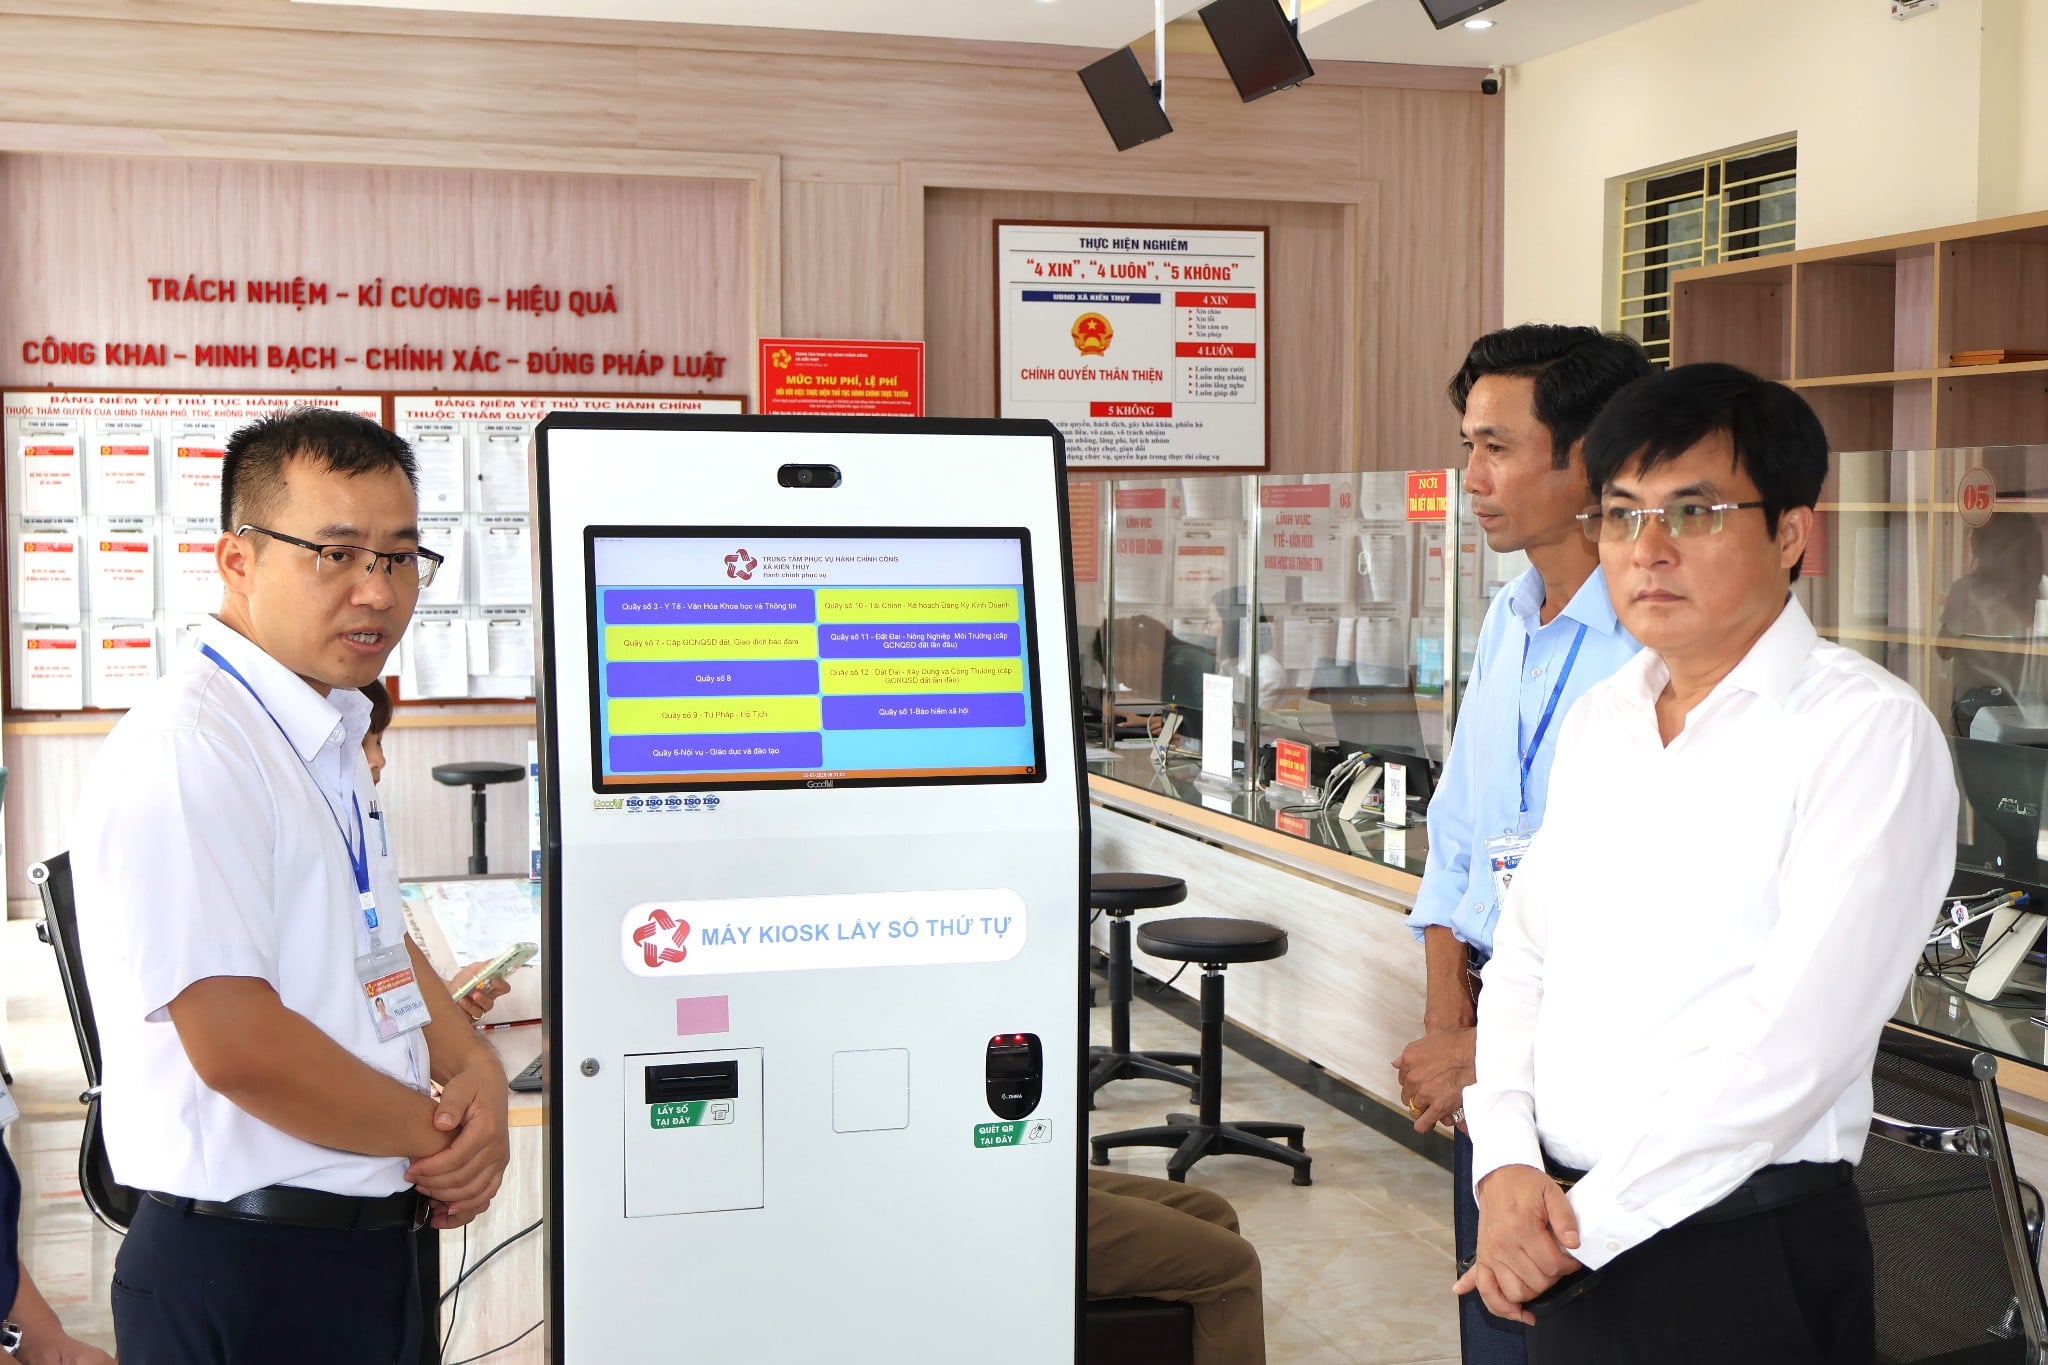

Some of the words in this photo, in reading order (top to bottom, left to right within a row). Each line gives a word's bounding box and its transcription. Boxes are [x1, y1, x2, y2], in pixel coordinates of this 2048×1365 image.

[1080, 238, 1109, 251] THỰC
[1113, 238, 1140, 252] HIỆN
[1144, 238, 1188, 251] NGHIÊM
[148, 274, 235, 302] TRÁCH
[248, 276, 327, 311] NHIỆM
[358, 277, 382, 307] KỈ
[391, 283, 481, 310] CƯƠNG
[506, 284, 560, 317] HIỆU
[568, 284, 618, 317] QUẢ
[1053, 293, 1075, 301] UBND
[1077, 293, 1088, 301] XÃ
[1090, 292, 1109, 302] KIẾN
[1111, 294, 1130, 303] THỤY
[1203, 295, 1208, 305] 4
[1210, 295, 1229, 305] XIN
[1197, 346, 1203, 356] 4
[1205, 344, 1234, 356] LUÔN
[22, 336, 95, 364] CÔNG
[105, 343, 166, 366] KHAI
[195, 344, 257, 367] MINH
[267, 345, 336, 374] BẠCH
[366, 344, 442, 371] CHÍNH
[452, 345, 500, 372] XÁC
[527, 347, 594, 374] ĐÚNG
[603, 350, 664, 377] PHÁP
[673, 351, 727, 382] LUẬT
[1021, 366, 1055, 380] CHÍNH
[1058, 364, 1096, 381] QUYỀN
[1099, 367, 1129, 381] THÂN
[1131, 367, 1163, 384] THIỆN
[786, 374, 812, 385] MỨC
[816, 376, 837, 385] THU
[840, 375, 861, 386] PHÍ,
[865, 375, 875, 387] LỆ
[879, 376, 897, 386] PHÍ
[50, 394, 94, 404] BẢNG
[99, 395, 138, 405] NIÊM
[143, 394, 170, 405] YẾT
[176, 394, 205, 406] THỦ
[213, 398, 240, 407] TỤC
[246, 397, 289, 406] HÀNH
[294, 397, 339, 407] CHÍNH
[435, 397, 475, 407] BẢNG
[480, 398, 515, 408] NIÊM
[520, 398, 546, 408] YẾT
[552, 397, 578, 409] THỦ
[584, 400, 611, 411] TỤC
[616, 399, 656, 410] HÀNH
[660, 399, 702, 411] CHÍNH
[1108, 406, 1114, 416] 5
[1116, 404, 1154, 416] KHÔNG
[1418, 477, 1438, 489] NƠI
[1339, 490, 1351, 509] 03
[1963, 484, 1990, 510] 05
[1276, 511, 1292, 526] LĨNH
[1294, 514, 1311, 528] VỰC
[789, 555, 802, 563] TÂM
[804, 556, 823, 564] PHỤC
[825, 556, 834, 564] VỤ
[835, 555, 854, 563] HÀNH
[856, 554, 877, 563] CHÍNH
[878, 555, 899, 563] CÔNG
[695, 674, 714, 683] Quầy
[626, 799, 643, 807] ISO
[646, 799, 663, 807] ISO
[665, 798, 682, 806] ISO
[703, 797, 720, 805] ISO
[701, 923, 752, 946] MÁY
[759, 921, 831, 943] KIOSK
[837, 918, 881, 941] LẤY
[887, 916, 919, 938] SỐ
[925, 914, 974, 937] THỨ
[979, 915, 1012, 940] TỰ
[657, 1104, 673, 1115] LẤY
[675, 1103, 689, 1114] SỐ
[655, 1117, 670, 1128] TẠI
[673, 1115, 691, 1126] ĐÂY
[979, 1124, 1000, 1135] QUÉT
[1002, 1125, 1014, 1133] QR
[980, 1135, 994, 1146] TẠI
[996, 1133, 1014, 1144] ĐÂY
